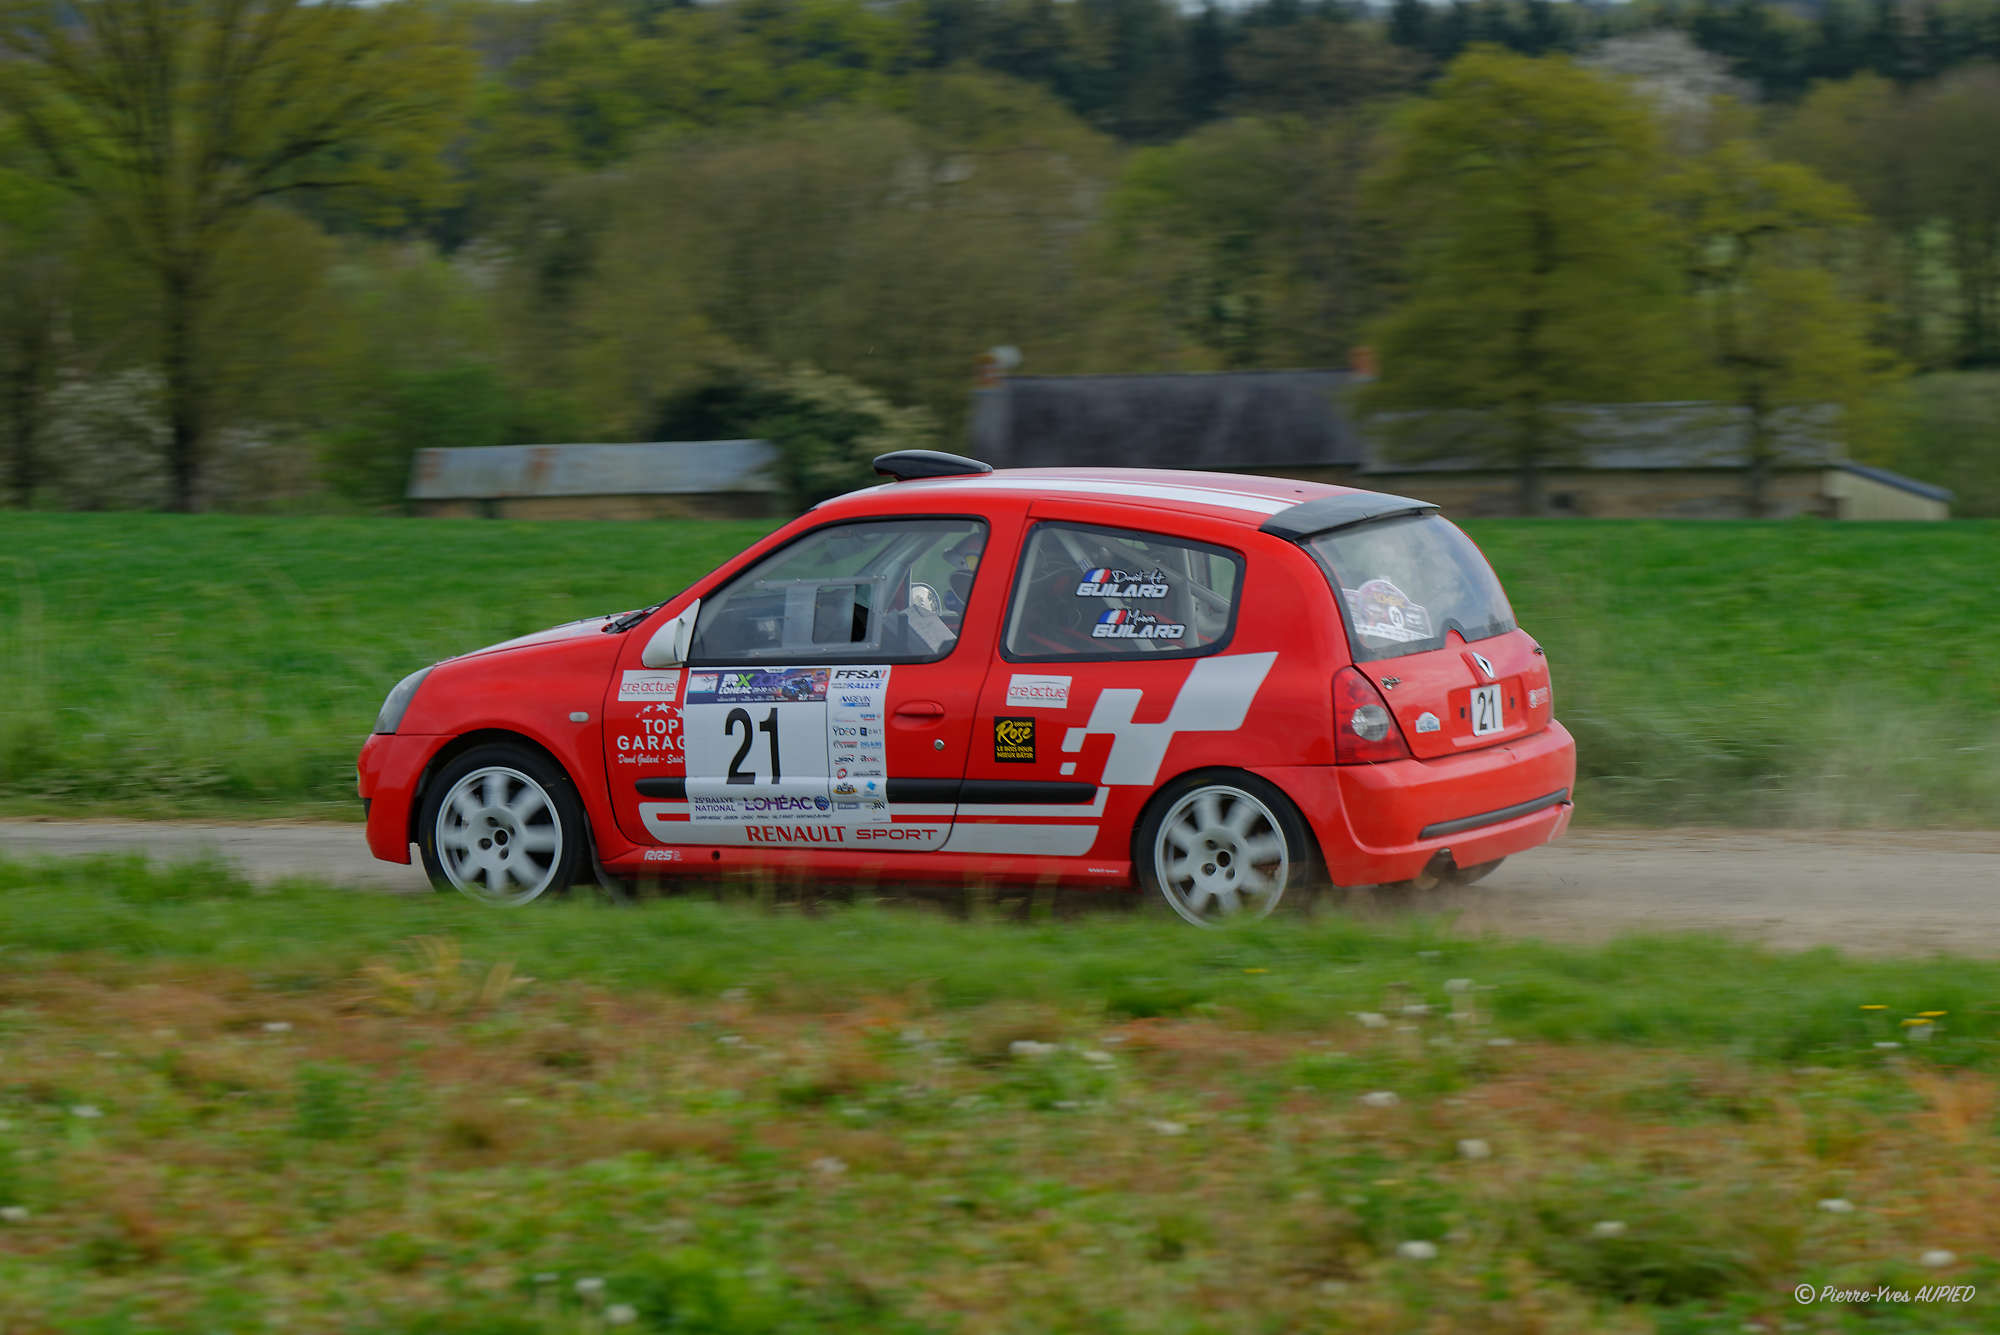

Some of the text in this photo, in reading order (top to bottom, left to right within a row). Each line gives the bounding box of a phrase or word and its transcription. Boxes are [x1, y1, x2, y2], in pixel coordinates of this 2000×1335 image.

[1076, 582, 1169, 598] GUILARD
[1092, 624, 1185, 639] GUILARD
[834, 670, 880, 679] FFSA
[1477, 689, 1496, 731] 21
[642, 719, 679, 734] TOP
[995, 720, 1033, 746] Rose
[724, 707, 781, 785] 21
[695, 794, 813, 812] NATIONAL LOHÉAC
[744, 825, 938, 843] RENAULT SPORT
